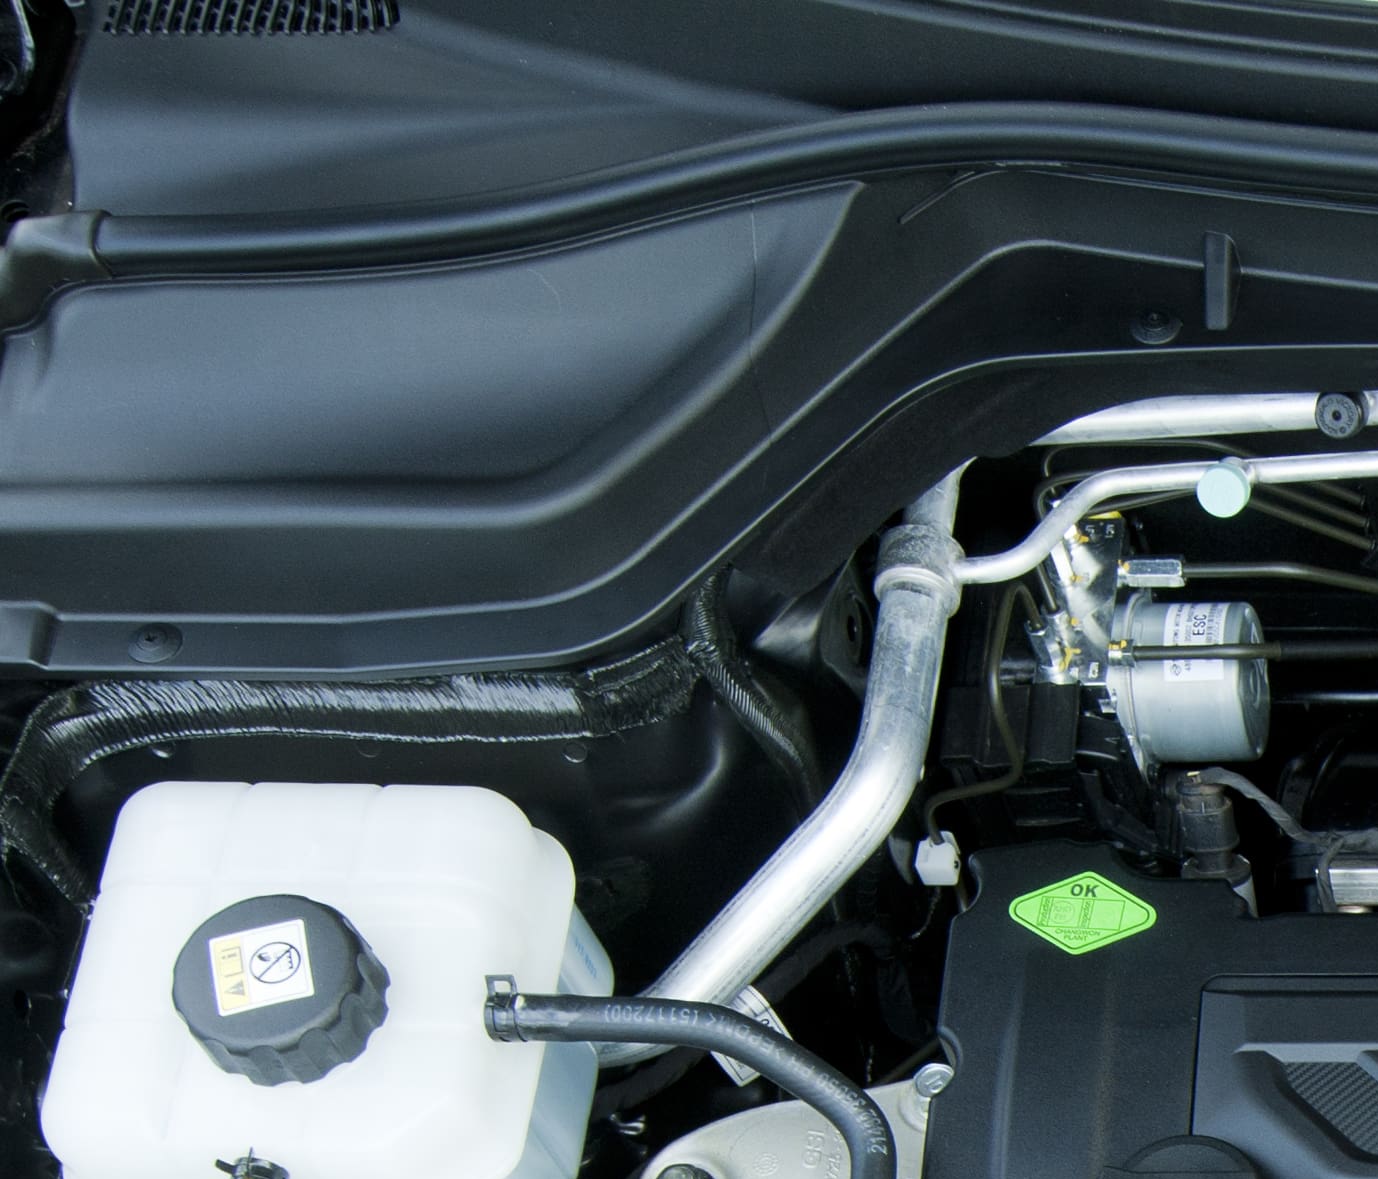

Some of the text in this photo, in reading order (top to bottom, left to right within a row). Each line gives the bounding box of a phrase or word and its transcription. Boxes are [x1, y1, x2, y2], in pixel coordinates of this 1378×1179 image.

[1192, 612, 1207, 637] ESC
[1071, 883, 1100, 898] OK
[1054, 928, 1101, 936] CHANGWON
[1063, 934, 1088, 942] PLANT
